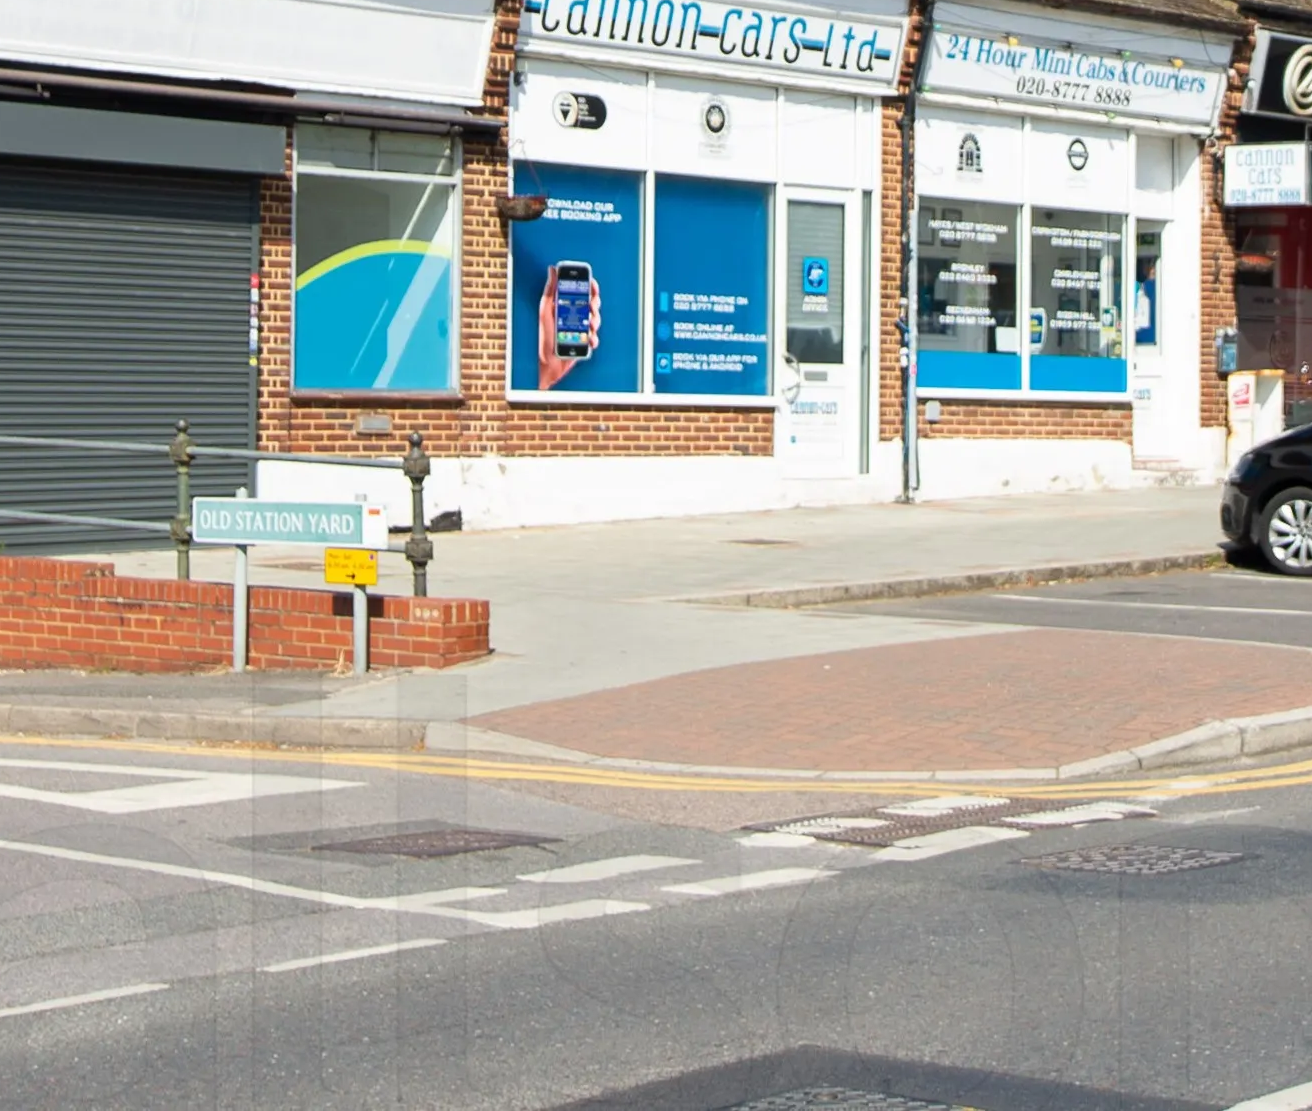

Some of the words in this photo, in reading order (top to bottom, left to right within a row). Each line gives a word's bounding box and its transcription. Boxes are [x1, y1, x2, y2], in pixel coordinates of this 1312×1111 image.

[945, 34, 970, 60] 24
[975, 38, 1027, 68] Hour
[1031, 47, 1072, 76] Mini
[1076, 54, 1115, 81] Cabs
[1131, 62, 1206, 93] Couriers
[1016, 75, 1090, 102] 020-8777
[1093, 84, 1131, 106] 8888
[1236, 148, 1295, 167] cannon
[1249, 168, 1282, 185] cars
[545, 198, 593, 211] OWNLOAD
[594, 202, 614, 212] OUR
[560, 210, 602, 222] BOOKING
[603, 213, 622, 223] APP
[673, 293, 695, 302] BOOK
[696, 294, 709, 303] VIA
[710, 295, 735, 305] PHONE
[736, 296, 749, 305] ON
[673, 322, 695, 330] BOOK
[696, 323, 723, 332] ONLINE
[673, 352, 694, 361] BOOK
[200, 509, 230, 531] OLD
[235, 511, 303, 533] STATION
[309, 513, 354, 535] YARD
